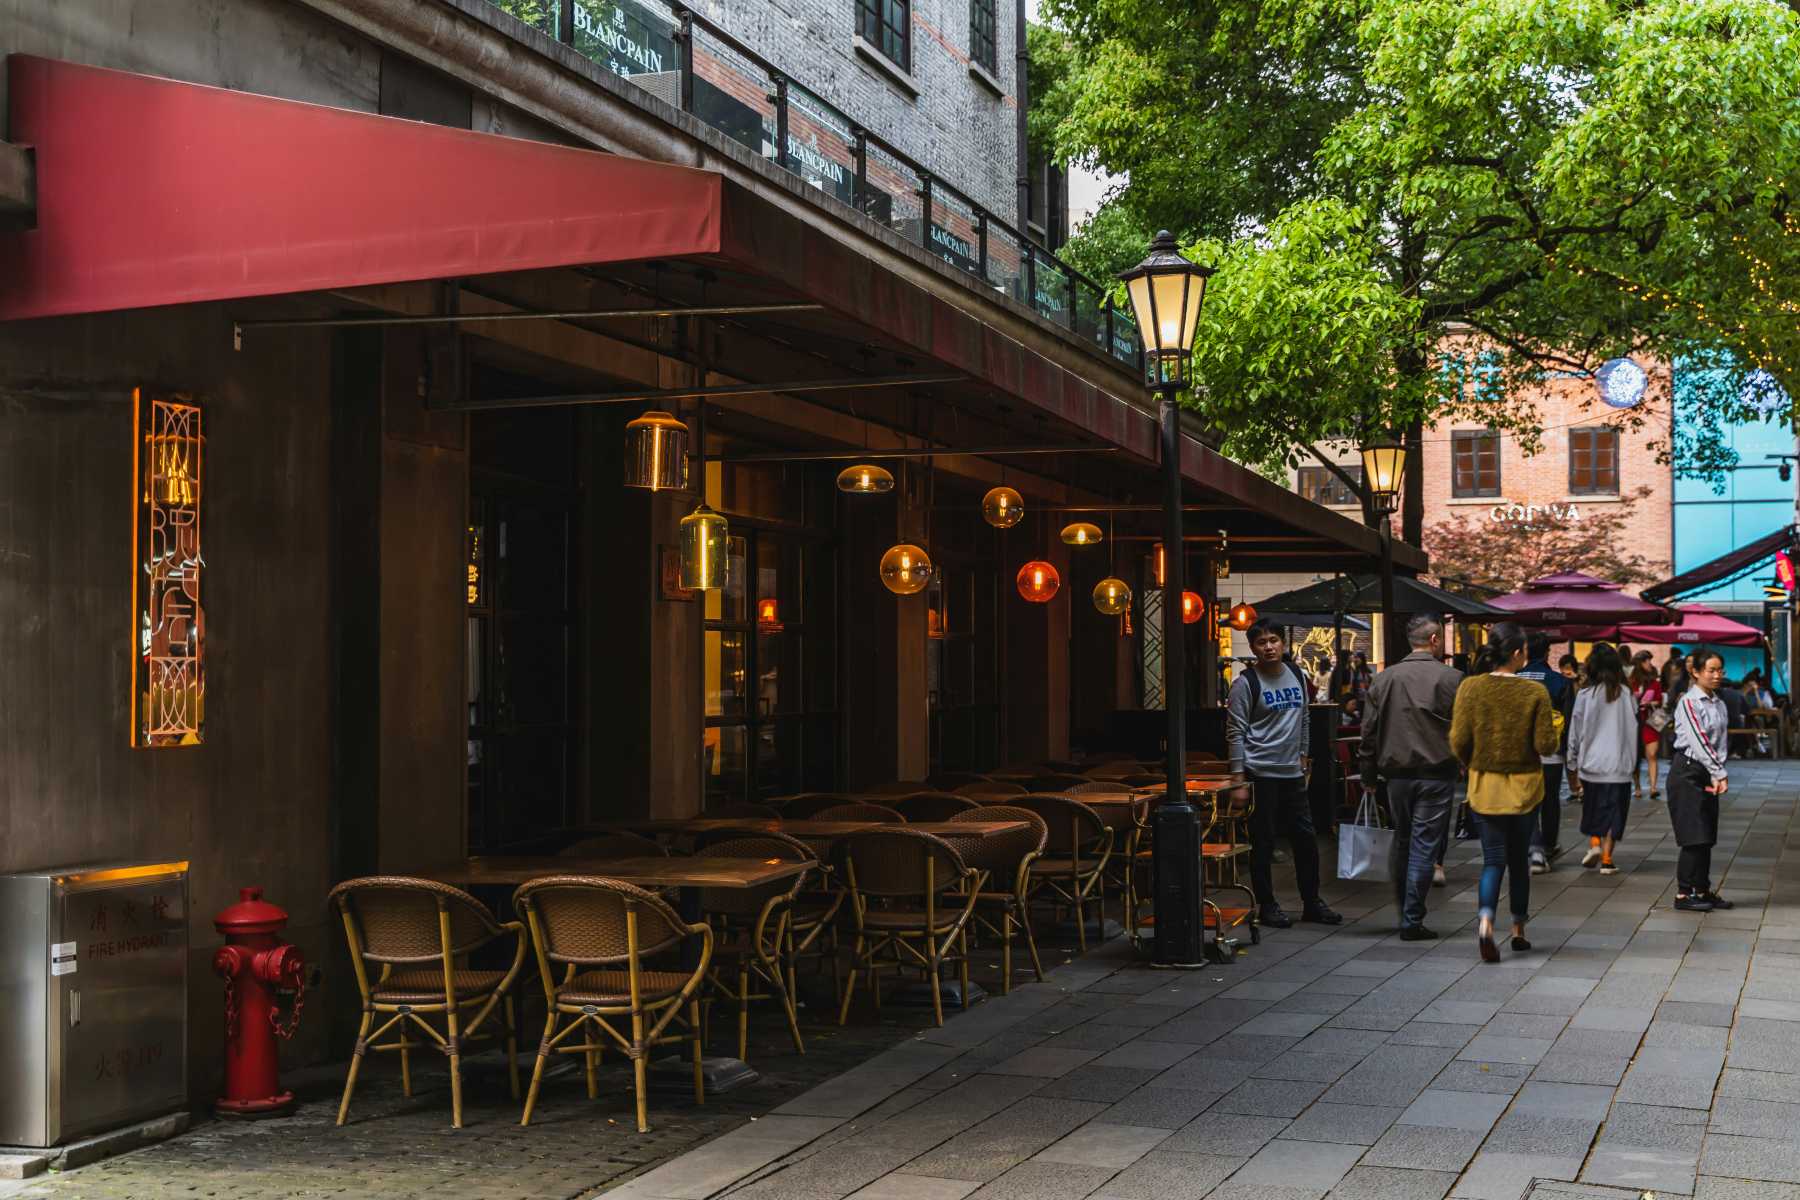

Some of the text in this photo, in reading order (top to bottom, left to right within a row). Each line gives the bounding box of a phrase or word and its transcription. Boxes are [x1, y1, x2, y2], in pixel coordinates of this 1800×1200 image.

[574, 2, 662, 78] BLANCPAIN
[931, 225, 969, 258] LANCPAIN
[1262, 687, 1302, 704] BAPE
[88, 941, 115, 960] FIRE
